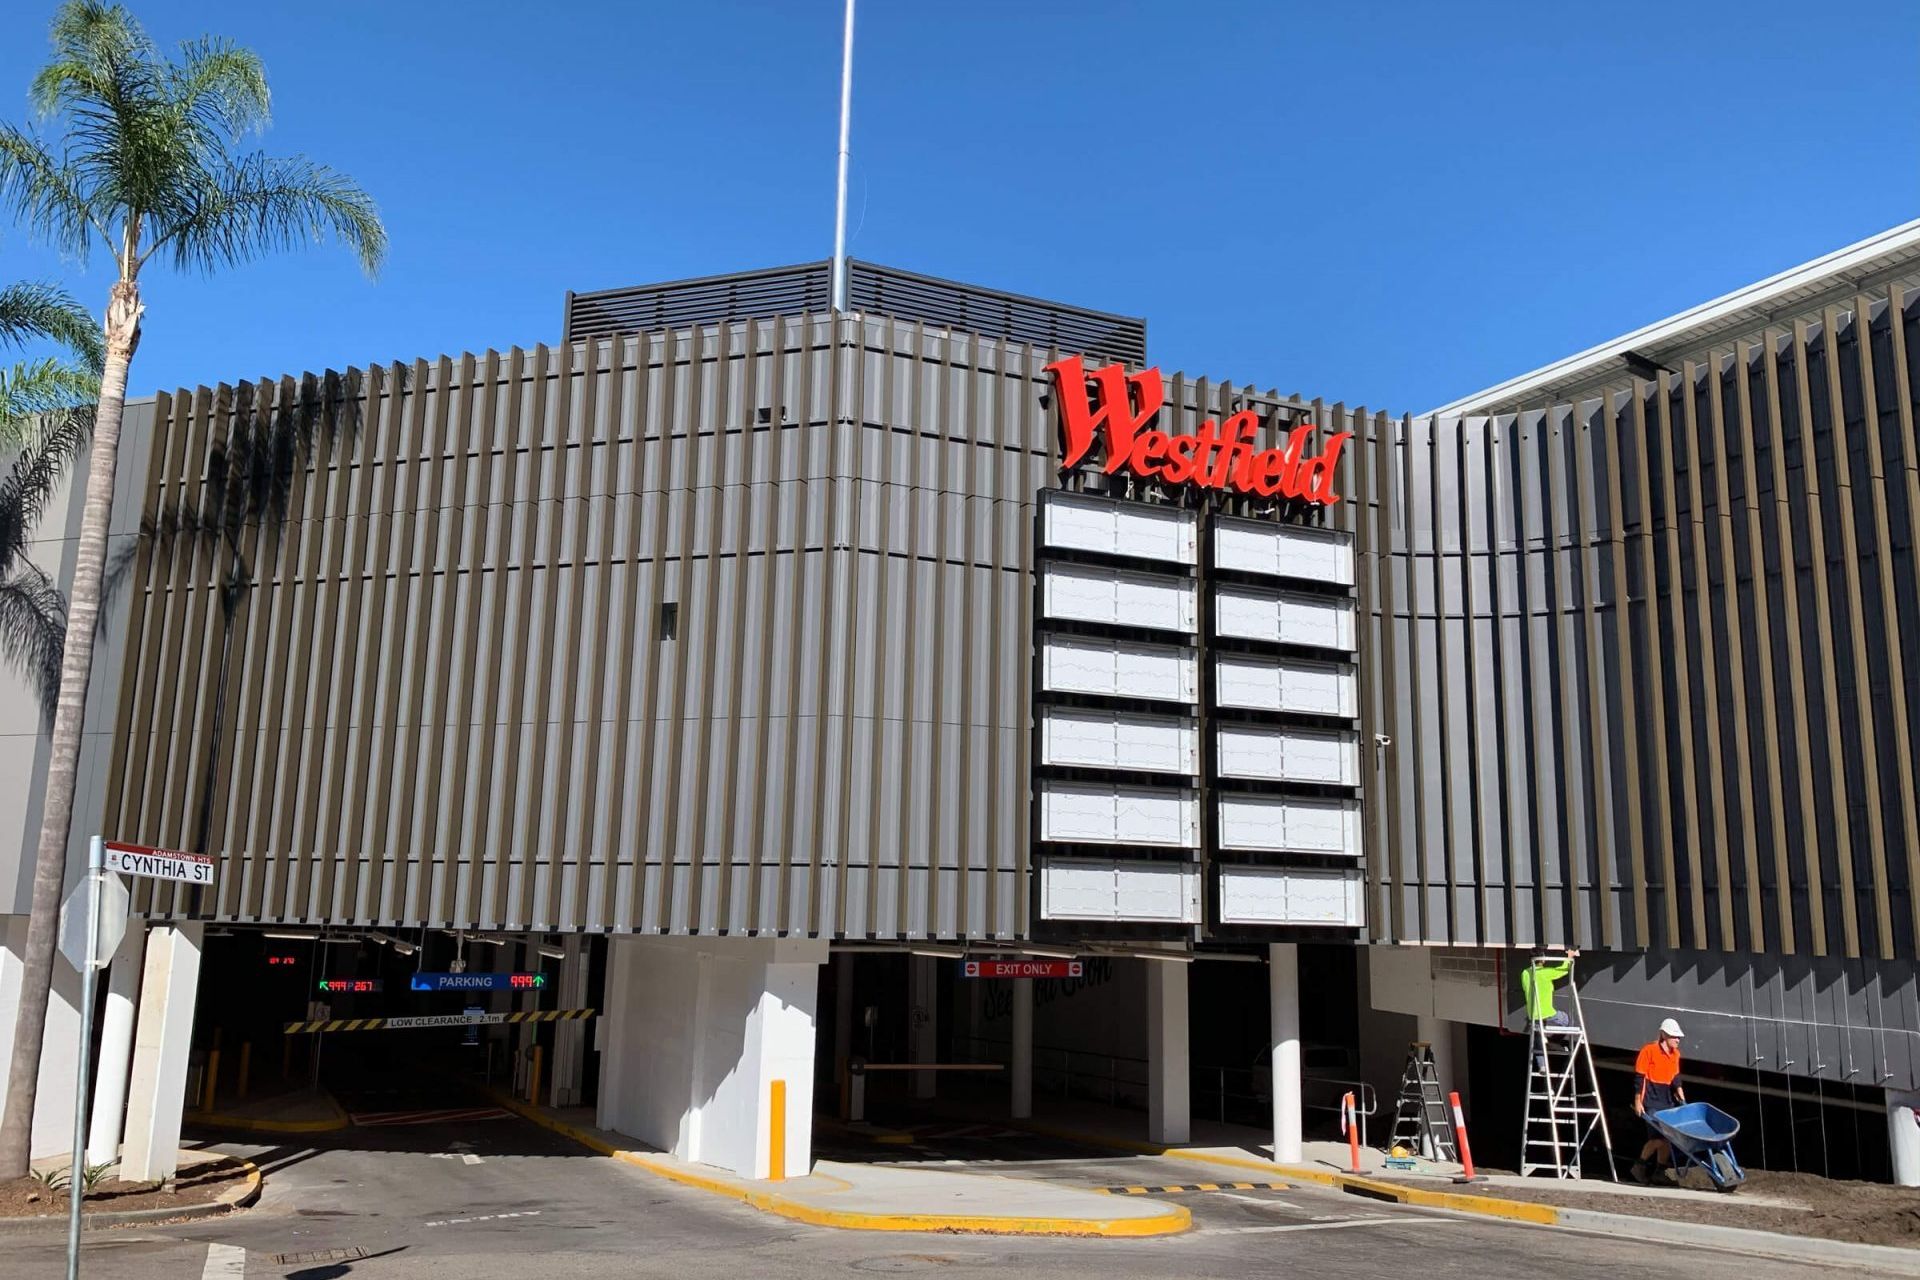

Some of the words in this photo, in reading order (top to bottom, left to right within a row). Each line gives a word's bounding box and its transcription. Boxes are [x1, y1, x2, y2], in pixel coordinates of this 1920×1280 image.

[1042, 355, 1352, 506] Westfield
[152, 849, 196, 862] ADAMSTOWN
[197, 857, 211, 865] HTS
[121, 853, 187, 879] CYNTHIA
[194, 864, 211, 881] ST
[996, 963, 1021, 975] EXIT
[1023, 963, 1053, 975] ONLY
[328, 981, 347, 991] 999
[354, 981, 373, 991] 267
[439, 976, 493, 988] PARKING
[510, 975, 533, 988] 999
[391, 1017, 413, 1027] LOW
[415, 1015, 473, 1026] CLEARANCE
[479, 1015, 500, 1023] 2.1m
